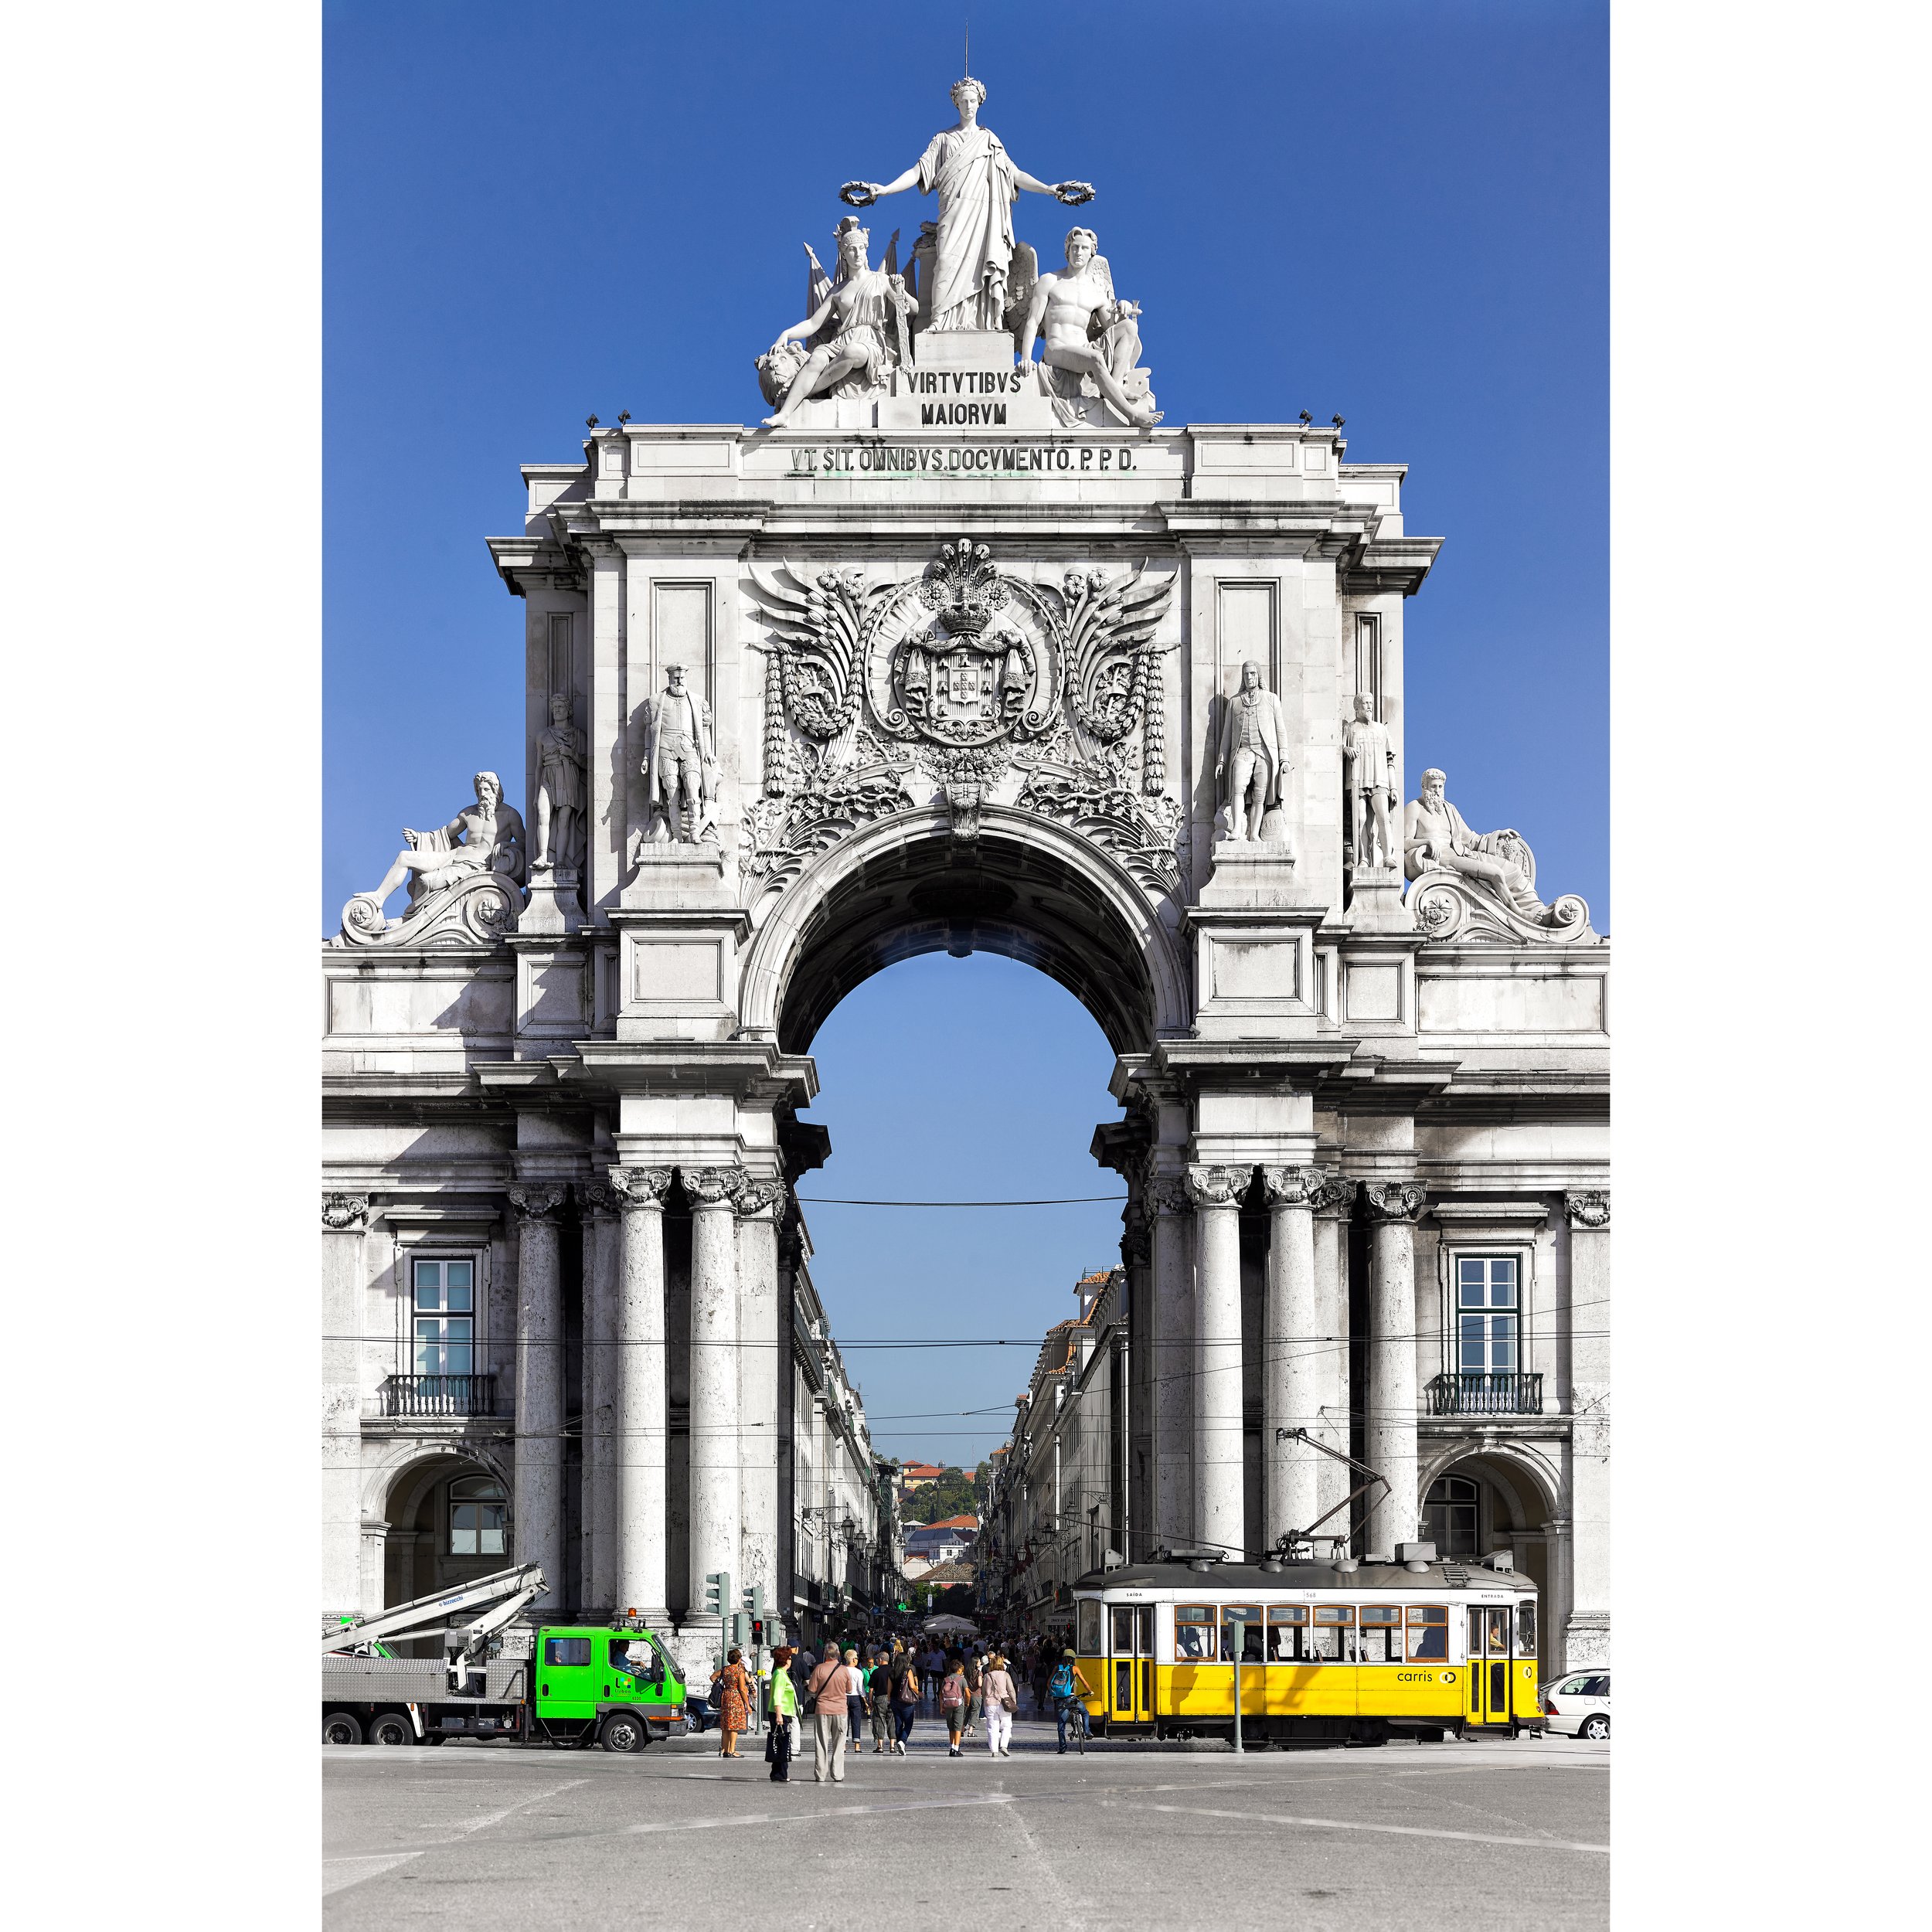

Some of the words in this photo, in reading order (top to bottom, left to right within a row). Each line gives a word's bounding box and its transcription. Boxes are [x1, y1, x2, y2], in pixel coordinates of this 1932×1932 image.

[907, 372, 1021, 393] VIRTVTIBVS
[921, 403, 1006, 425] MAIORVM
[823, 448, 854, 471] SIT.
[1397, 1670, 1433, 1682] carris
